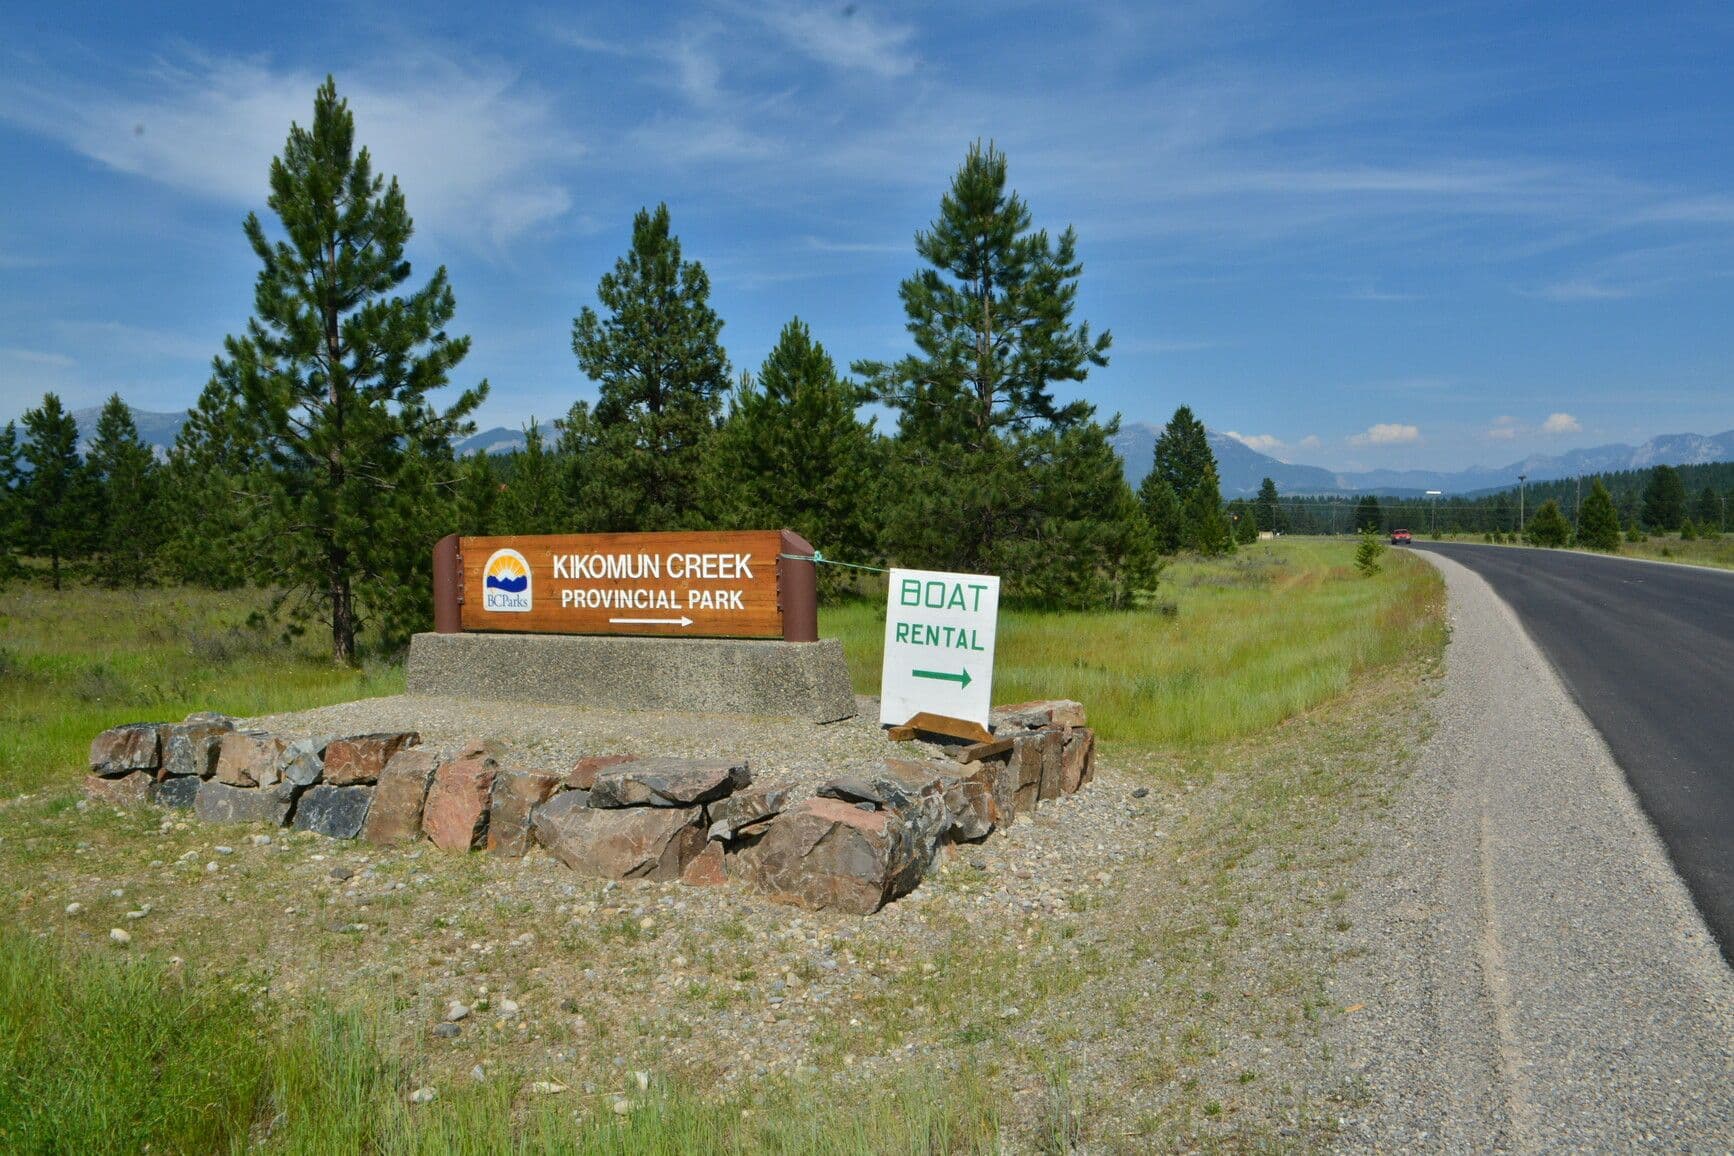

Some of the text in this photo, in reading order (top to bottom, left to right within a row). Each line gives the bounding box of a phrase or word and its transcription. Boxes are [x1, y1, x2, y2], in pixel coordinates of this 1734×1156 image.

[553, 553, 754, 580] KIKOMUN CREEK
[562, 589, 745, 610] PROVINCIAL PARK
[901, 578, 988, 612] BOAT
[896, 622, 985, 651] RENTAL
